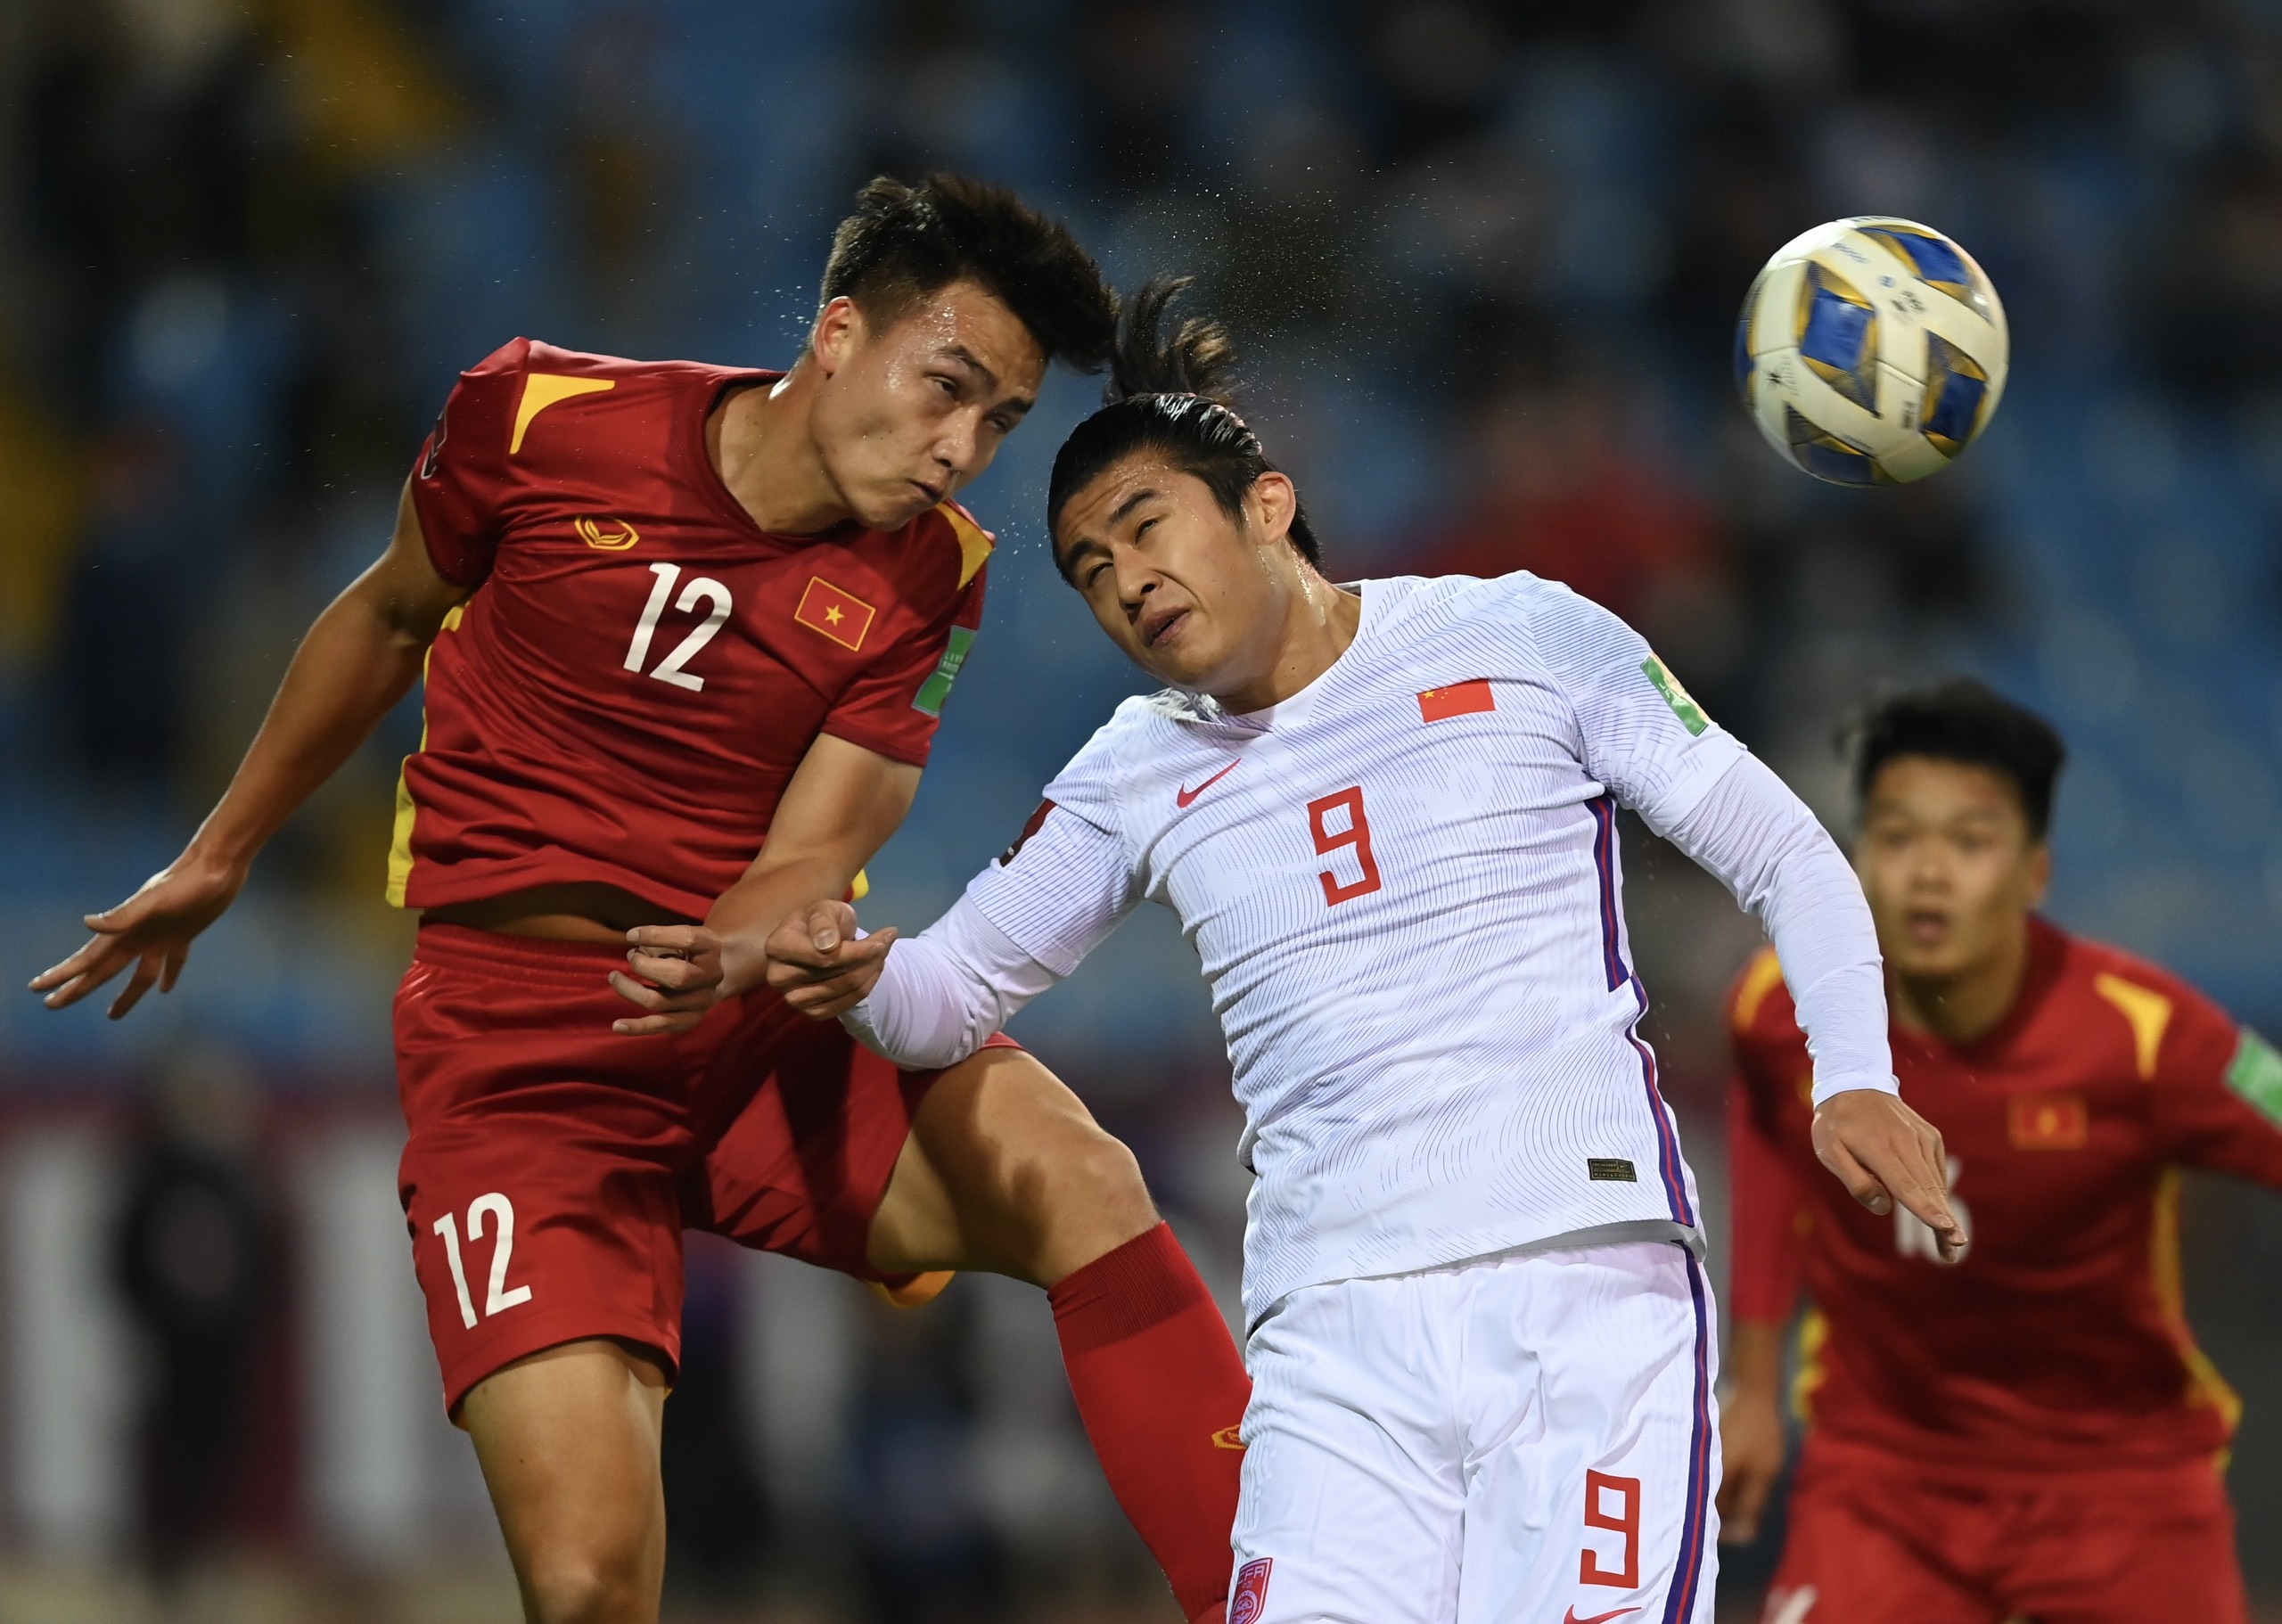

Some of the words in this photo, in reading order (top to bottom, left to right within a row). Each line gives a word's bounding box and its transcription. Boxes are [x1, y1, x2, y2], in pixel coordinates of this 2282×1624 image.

[622, 562, 734, 693] 12
[1306, 785, 1382, 907] 9
[432, 1192, 533, 1330] 12
[1579, 1468, 1641, 1589] 9
